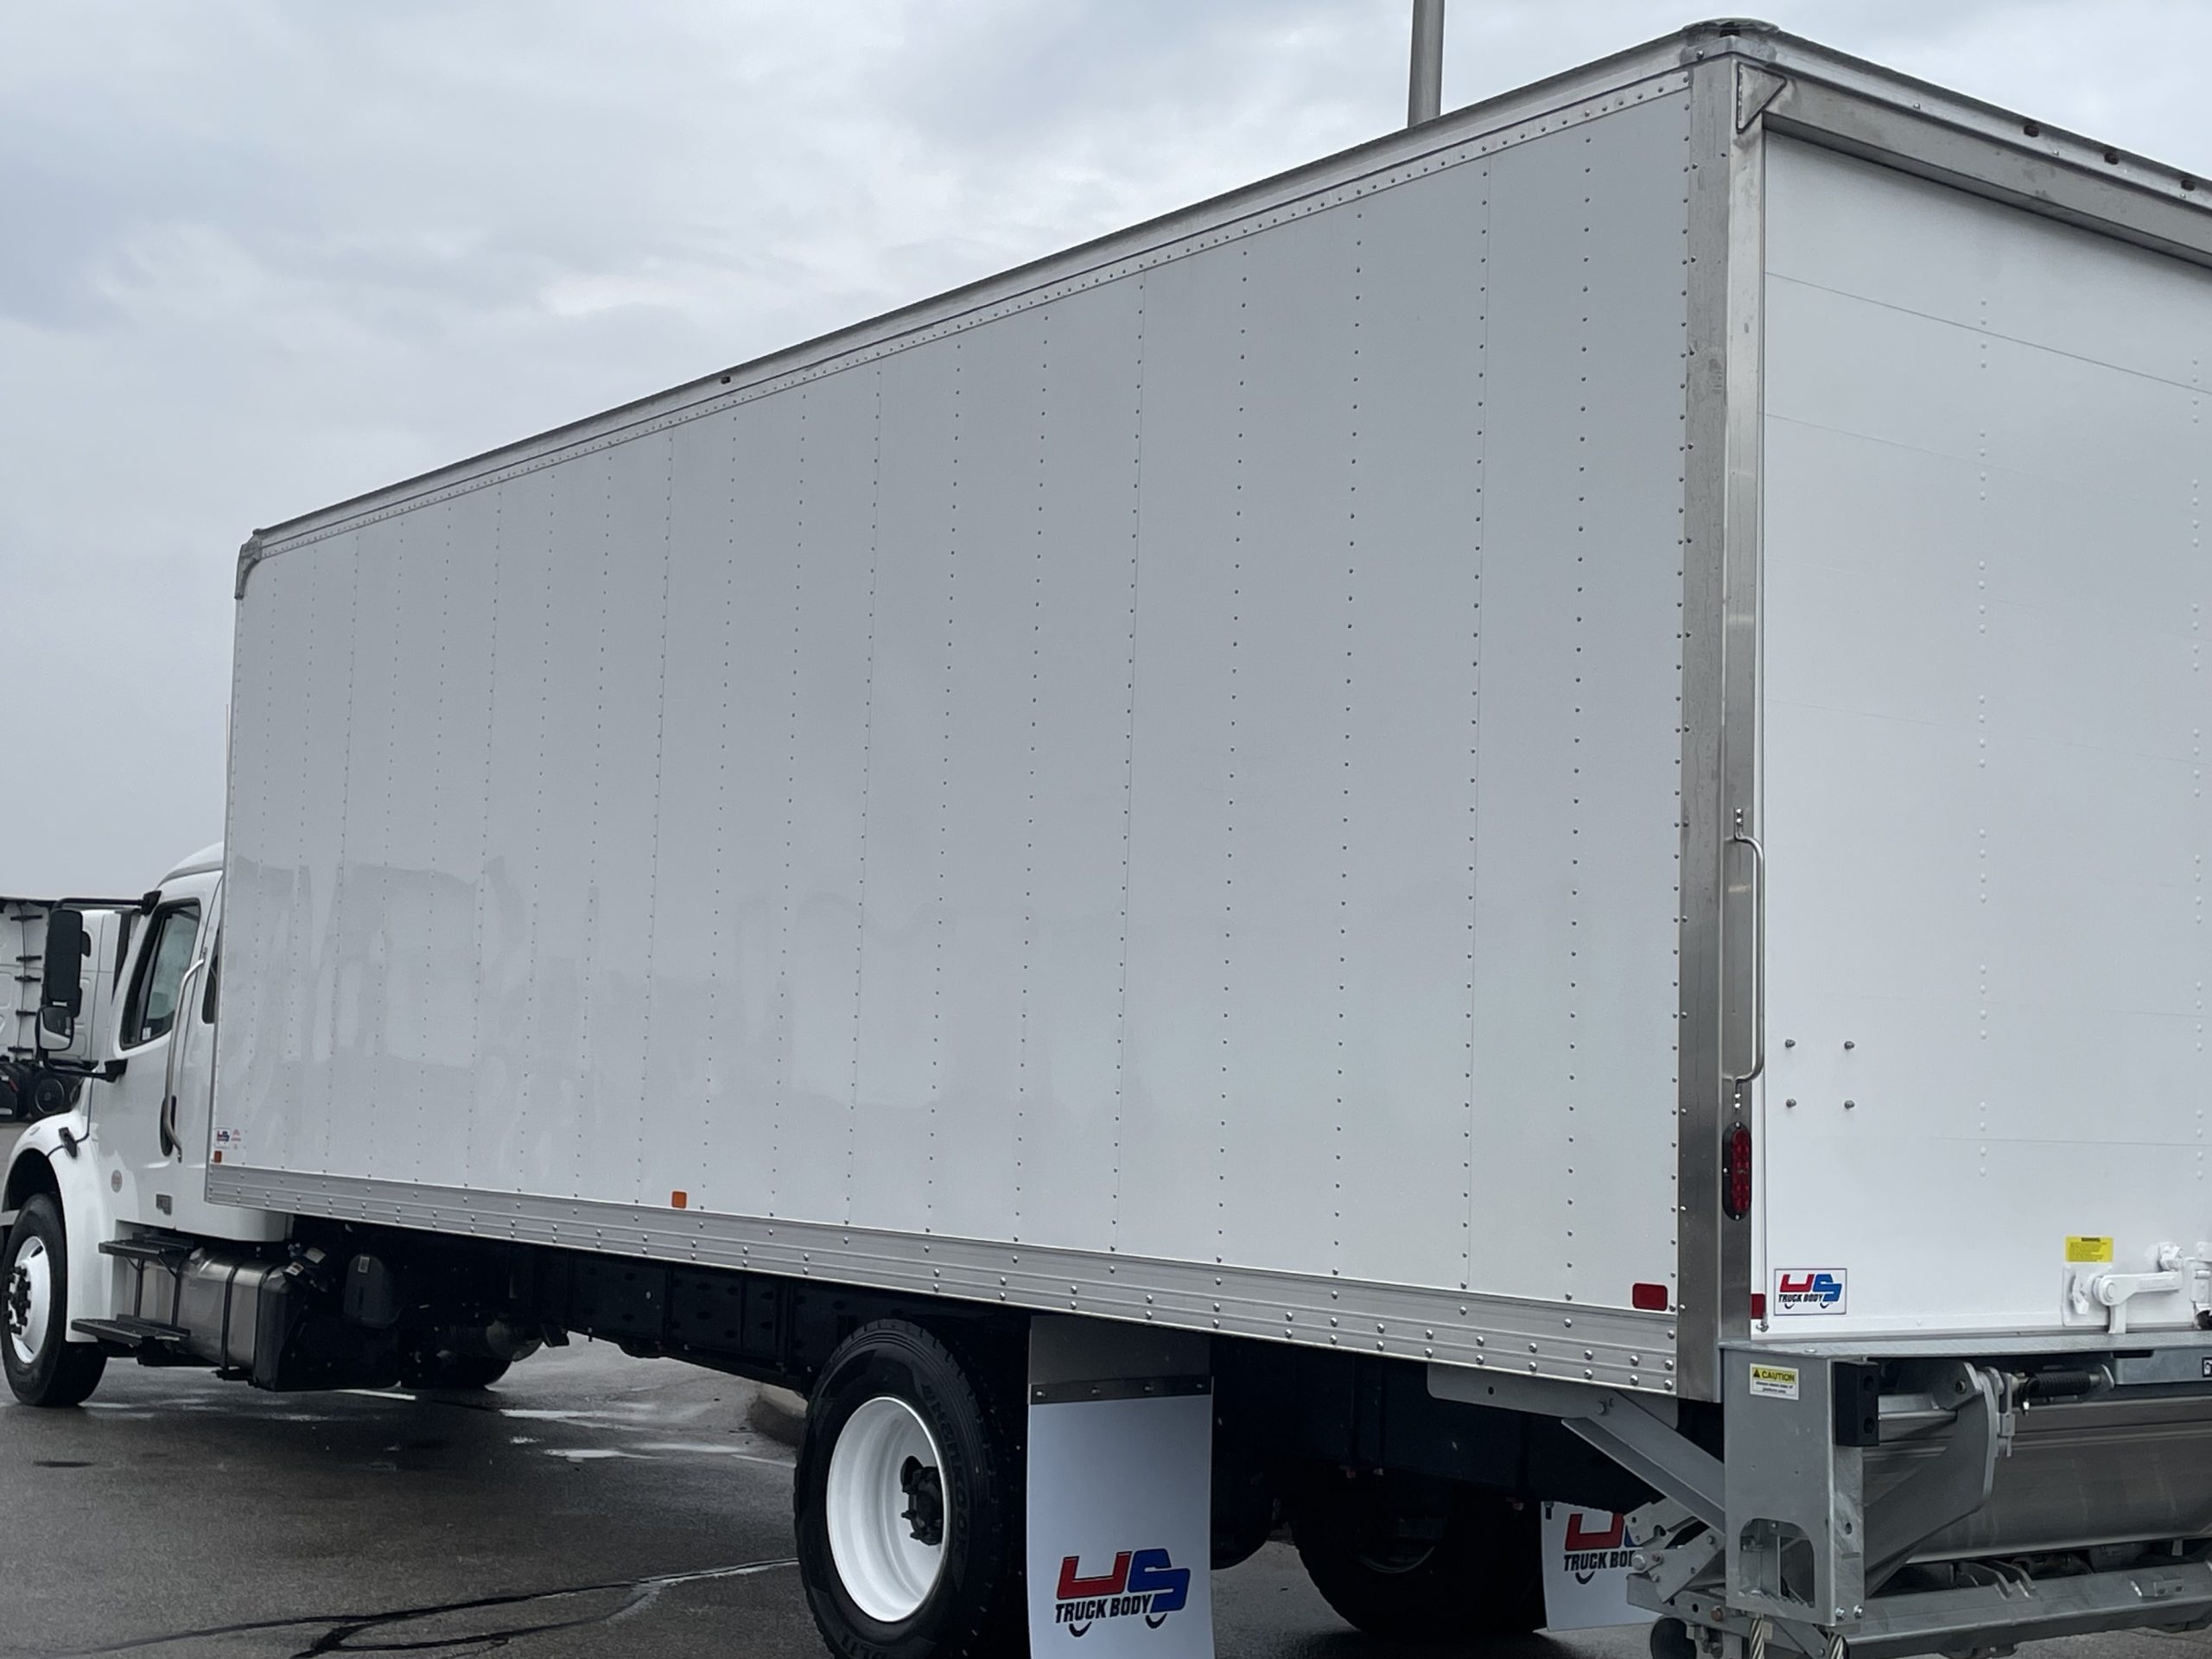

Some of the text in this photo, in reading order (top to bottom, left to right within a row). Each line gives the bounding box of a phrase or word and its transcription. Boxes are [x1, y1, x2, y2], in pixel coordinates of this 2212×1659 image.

[1778, 1294, 1823, 1303] TRUCK BODY
[1779, 1274, 1842, 1302] US
[1762, 1370, 1795, 1382] CAUTION
[1565, 1511, 1638, 1551] U
[1564, 1550, 1636, 1572] TRUCK BO
[1056, 1548, 1191, 1614] US
[1055, 1594, 1153, 1624] TRUCK BODY
